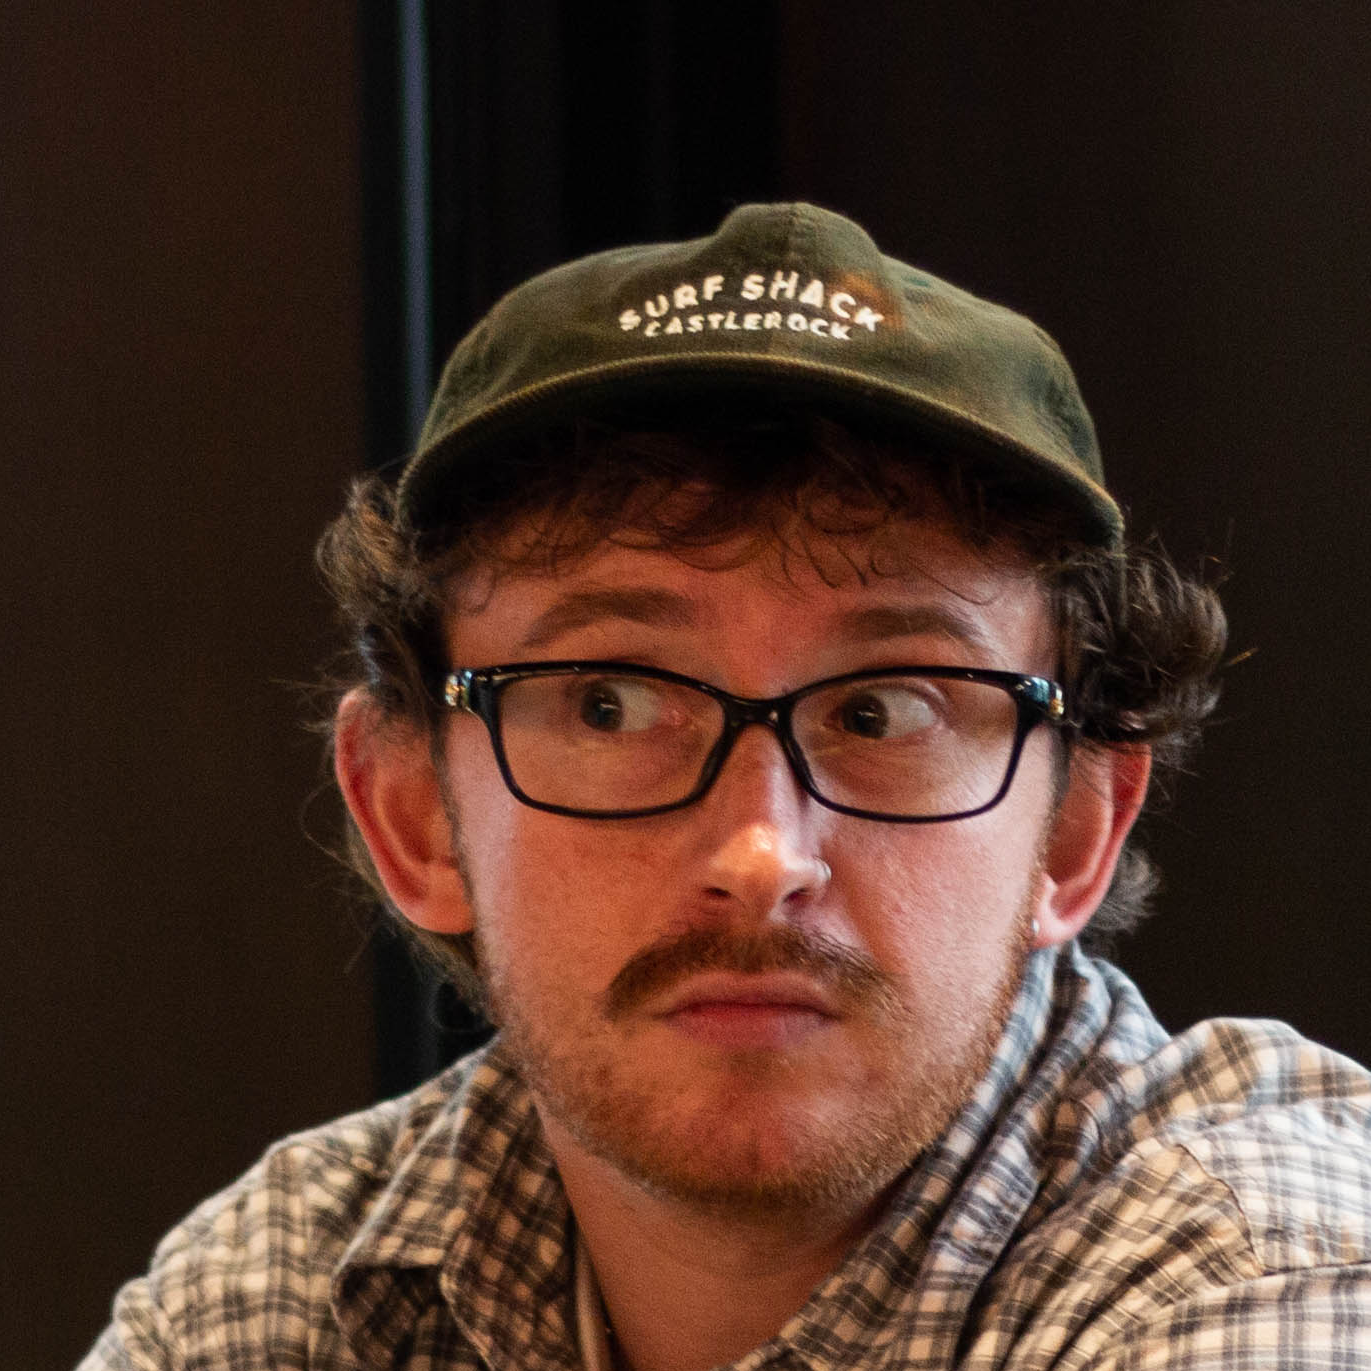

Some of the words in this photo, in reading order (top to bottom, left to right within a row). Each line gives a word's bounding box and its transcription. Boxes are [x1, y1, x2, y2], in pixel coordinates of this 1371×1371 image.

[619, 275, 724, 331] SURF
[741, 270, 884, 333] SHACK
[644, 311, 851, 341] CASTLEROCK
